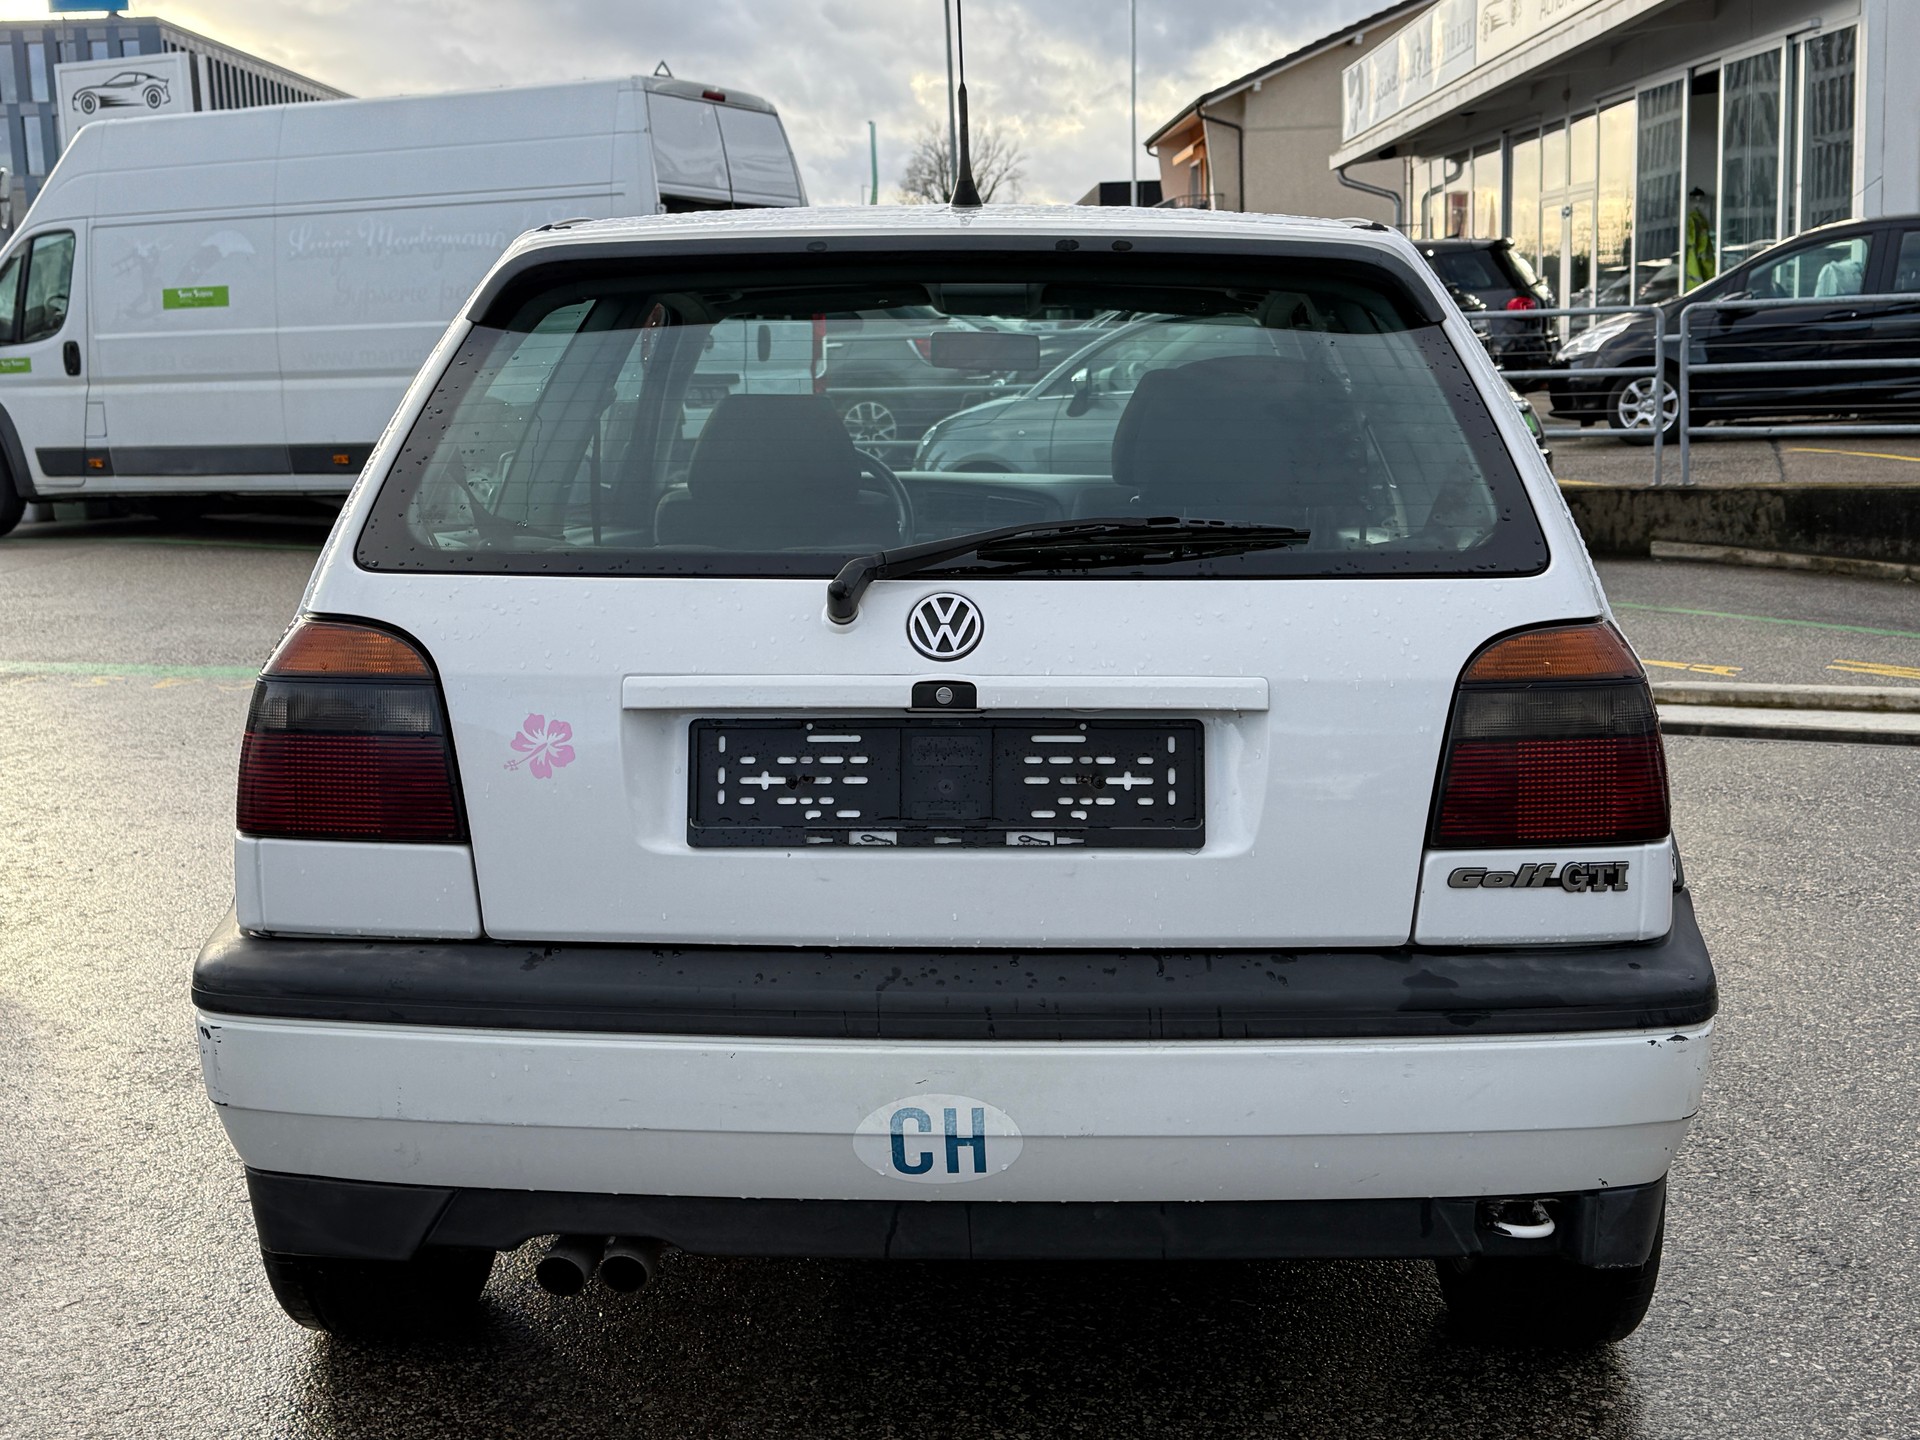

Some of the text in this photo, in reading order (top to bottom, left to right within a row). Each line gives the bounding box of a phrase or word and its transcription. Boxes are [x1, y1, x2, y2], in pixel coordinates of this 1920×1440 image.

[910, 593, 982, 658] VW
[1447, 860, 1630, 893] Golf GTI
[889, 1107, 988, 1175] CH
